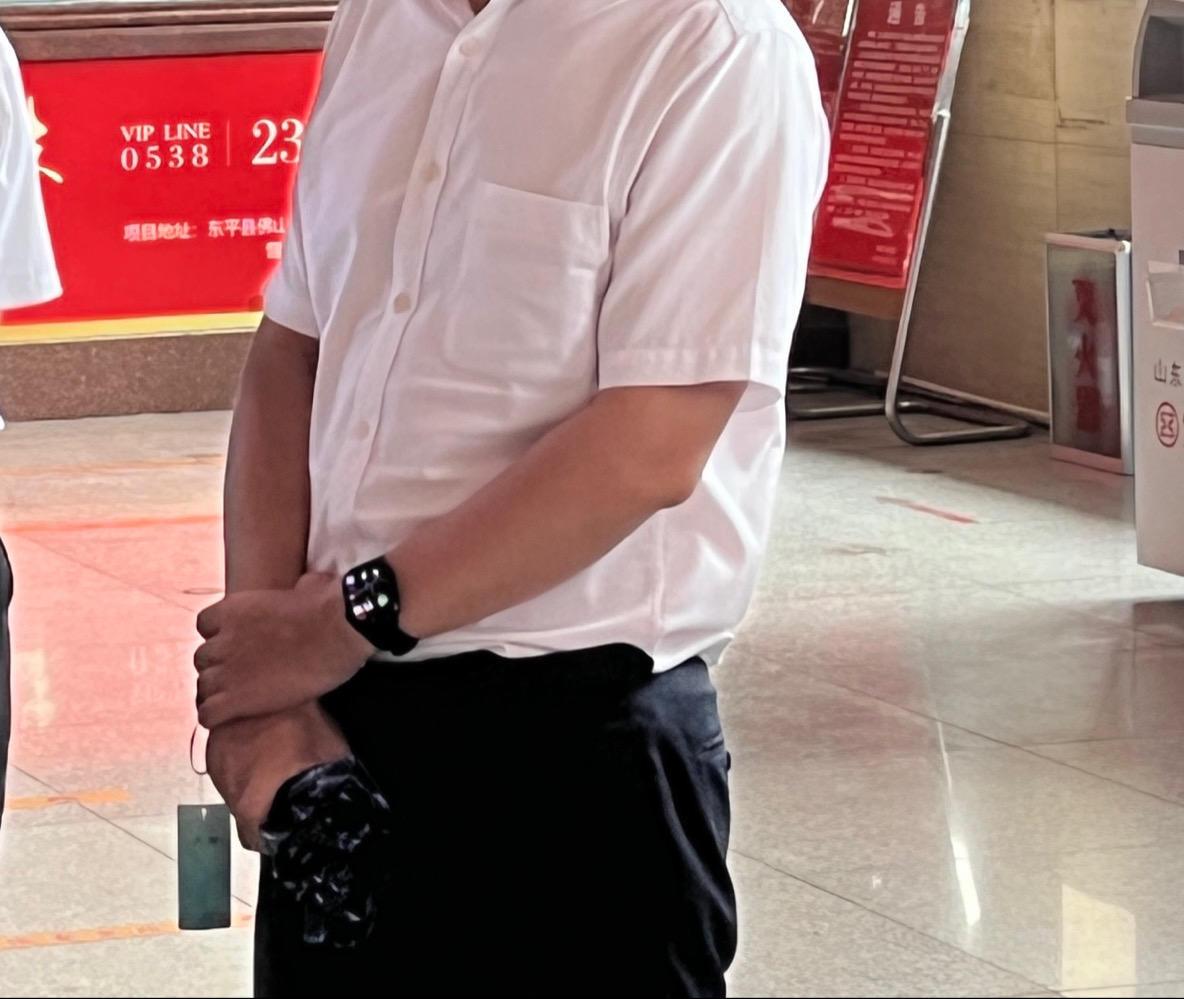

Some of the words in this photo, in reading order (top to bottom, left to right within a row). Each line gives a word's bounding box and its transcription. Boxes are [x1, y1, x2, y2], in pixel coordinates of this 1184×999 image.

[120, 124, 156, 143] VIP
[164, 122, 212, 142] LINE
[120, 143, 210, 172] 0538
